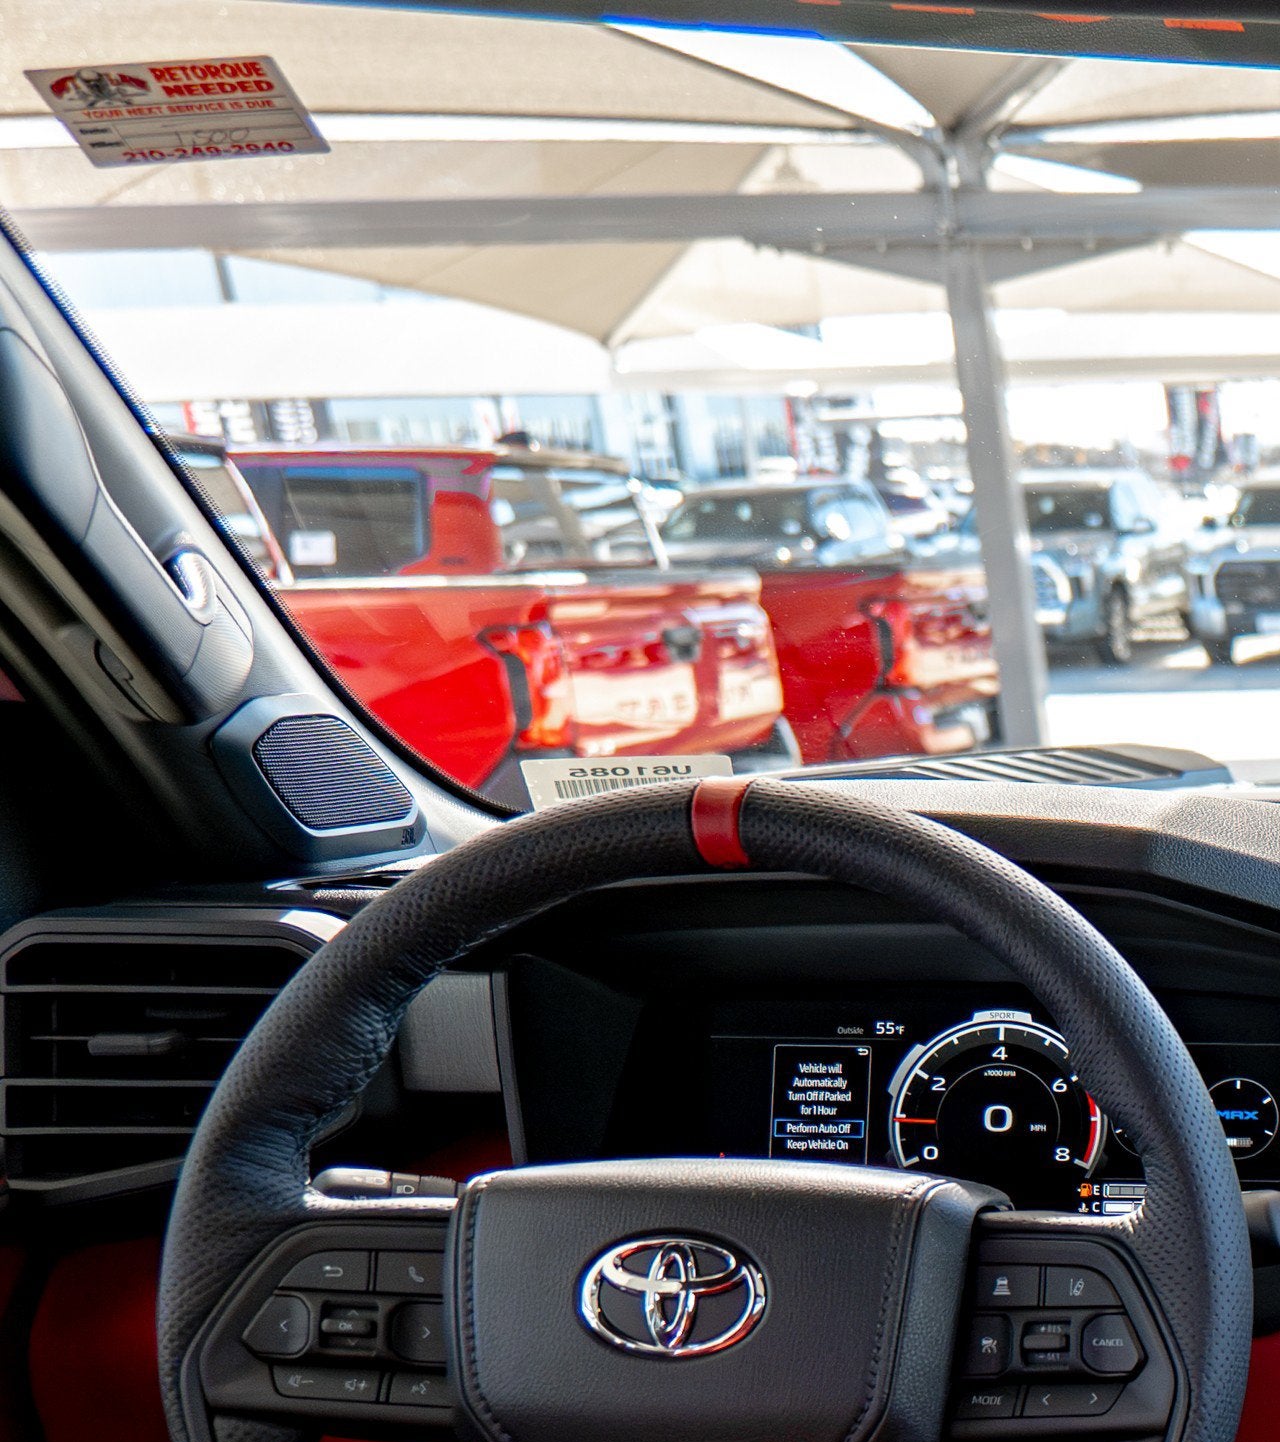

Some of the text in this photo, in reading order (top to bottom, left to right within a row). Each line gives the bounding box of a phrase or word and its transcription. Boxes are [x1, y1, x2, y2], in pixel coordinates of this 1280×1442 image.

[148, 61, 267, 83] RETORQUE
[161, 80, 275, 99] NEEDED
[82, 99, 276, 120] YOUR NEXT SERVICE IS DUE
[837, 1022, 906, 1035] Outside 55°F
[991, 1046, 1009, 1061] 4
[798, 1063, 842, 1074] Vehicle will
[793, 1077, 847, 1090] Automatically
[931, 1077, 947, 1091] 2
[1052, 1078, 1068, 1093] 6
[788, 1091, 852, 1102] Turn Off if Parked
[800, 1105, 838, 1116] for 1 Hour
[1216, 1110, 1259, 1120] MAX
[984, 1105, 1047, 1132] 0 MPH
[786, 1123, 851, 1134] Perform Auto Off
[787, 1140, 849, 1151] Keep Vehicle On
[922, 1146, 939, 1161] 0
[1055, 1147, 1070, 1162] 8
[1093, 1185, 1100, 1195] E
[1092, 1202, 1100, 1213] C
[1092, 1338, 1124, 1347] CANCEL
[971, 1395, 1003, 1406] MODE
